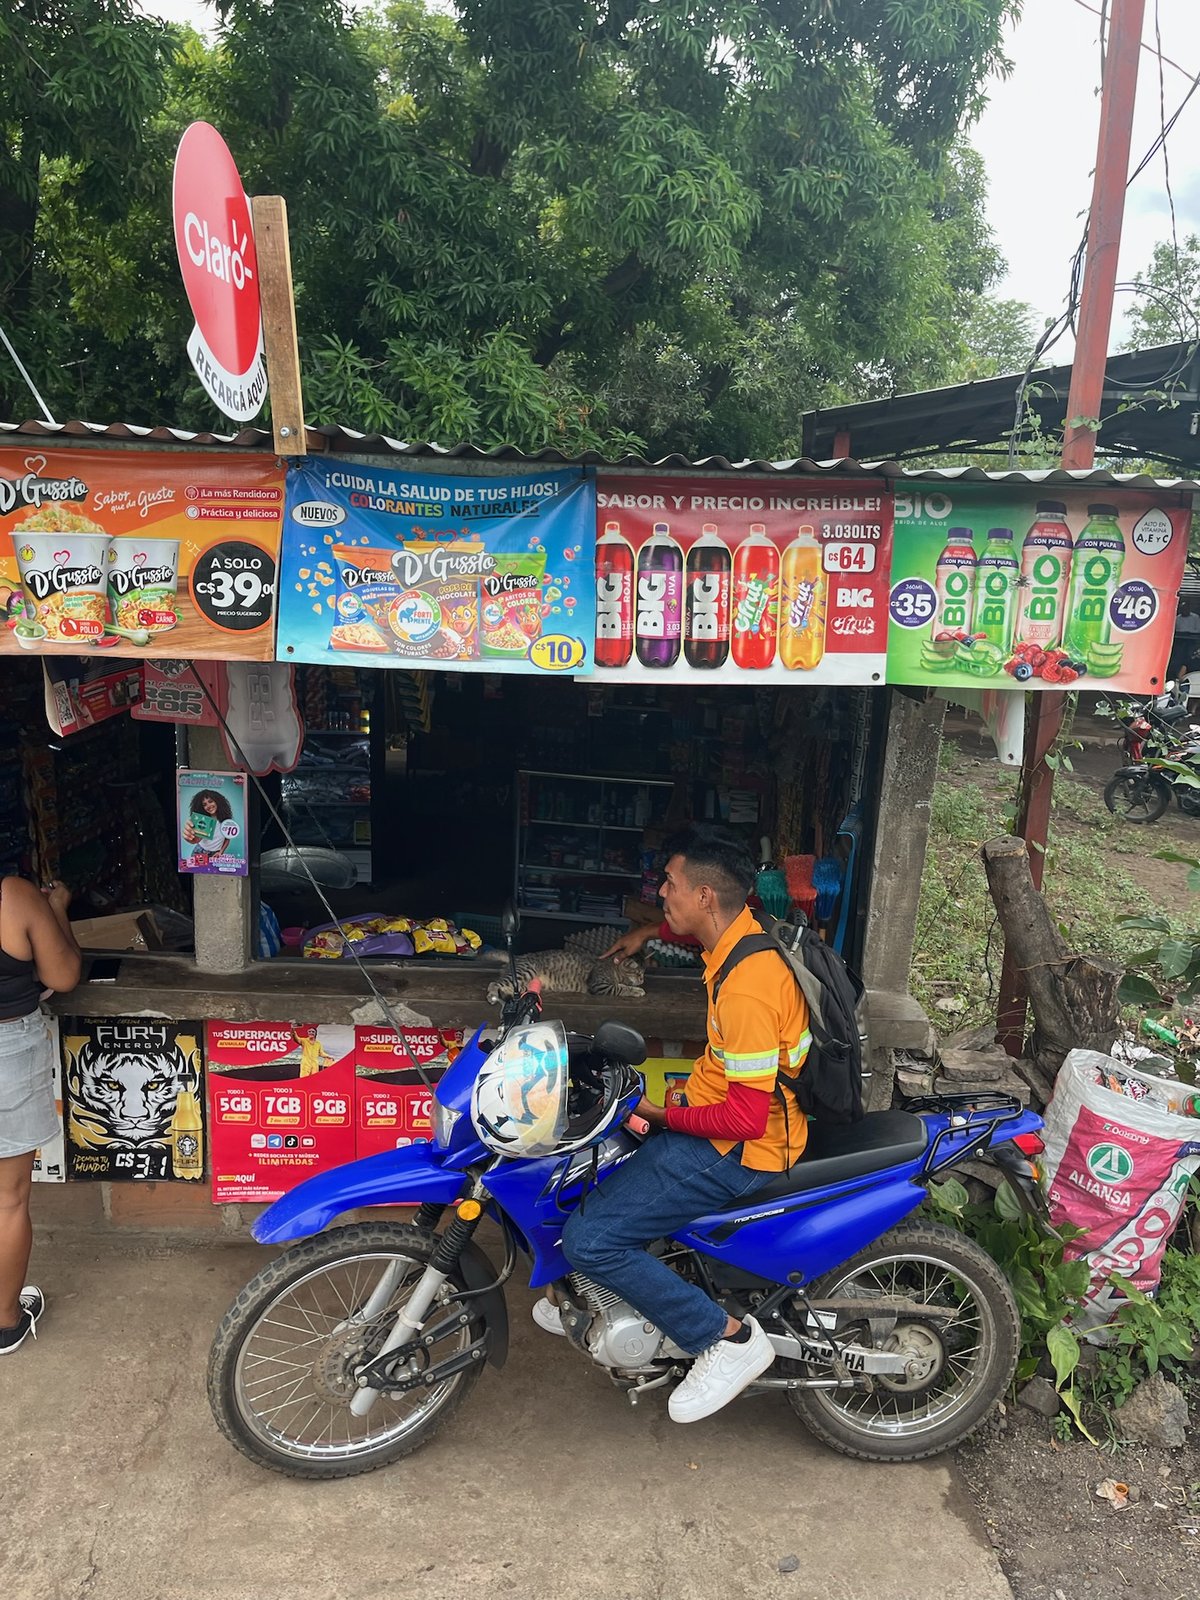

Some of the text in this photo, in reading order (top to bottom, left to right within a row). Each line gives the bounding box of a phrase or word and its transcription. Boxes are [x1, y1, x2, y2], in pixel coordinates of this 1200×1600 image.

[184, 212, 246, 291] Claro
[0, 473, 89, 512] D'Gussto
[216, 489, 232, 498] más
[233, 490, 278, 499] Rendidora!
[325, 472, 559, 501] ¡CUIDA LA SALUD DE TUS HIJOS!
[93, 486, 176, 517] Sabor que da Gusto
[351, 493, 539, 517] COLORANTES NATURALES
[597, 493, 881, 511] SABOR Y PRECIO INCREÍBLE!
[894, 491, 952, 519] BIO
[201, 508, 278, 519] Práctica y deliciosa
[300, 506, 338, 520] NUEVOS
[822, 525, 880, 539] 3.030LTS
[1162, 535, 1169, 543] C
[1099, 541, 1117, 549] PULPA
[211, 558, 261, 569] A SOLO
[392, 547, 497, 586] D'Gussto
[25, 565, 103, 598] D'Gussto
[110, 565, 174, 595] D'Gussto
[342, 567, 395, 586] D'Gussto
[485, 573, 538, 596] D'Gussto
[668, 574, 676, 595] UVA
[436, 591, 477, 602] CHOCOLATE
[623, 572, 631, 603] ROJA
[721, 579, 729, 608] COLA
[1030, 554, 1061, 621] BIO
[1080, 555, 1111, 622] BIO
[596, 573, 623, 638] BIG
[637, 573, 666, 636] BIG
[692, 574, 720, 639] BIG
[836, 588, 874, 608] BIG
[943, 572, 968, 626] BIO
[983, 572, 1008, 626] BIO
[80, 625, 99, 634] POLLO
[393, 640, 405, 649] CON
[456, 645, 466, 653] 25
[96, 1026, 167, 1047] FURY
[223, 1030, 291, 1040] SUPERPACKS
[370, 1034, 438, 1044] SUPEPACKS
[247, 1040, 287, 1052] GIGAS
[220, 1097, 252, 1112] 5GB
[265, 1097, 301, 1114] 7GB
[313, 1099, 346, 1114] 9GB
[366, 1102, 397, 1116] 5GB
[410, 1101, 432, 1116] 7G
[75, 1162, 110, 1172] MUNDO!
[259, 1158, 314, 1166] ILIMITADAS
[234, 1173, 256, 1183] AQUÍ
[1069, 1170, 1131, 1208] ALIANSA
[800, 1346, 866, 1371] YAMHA
